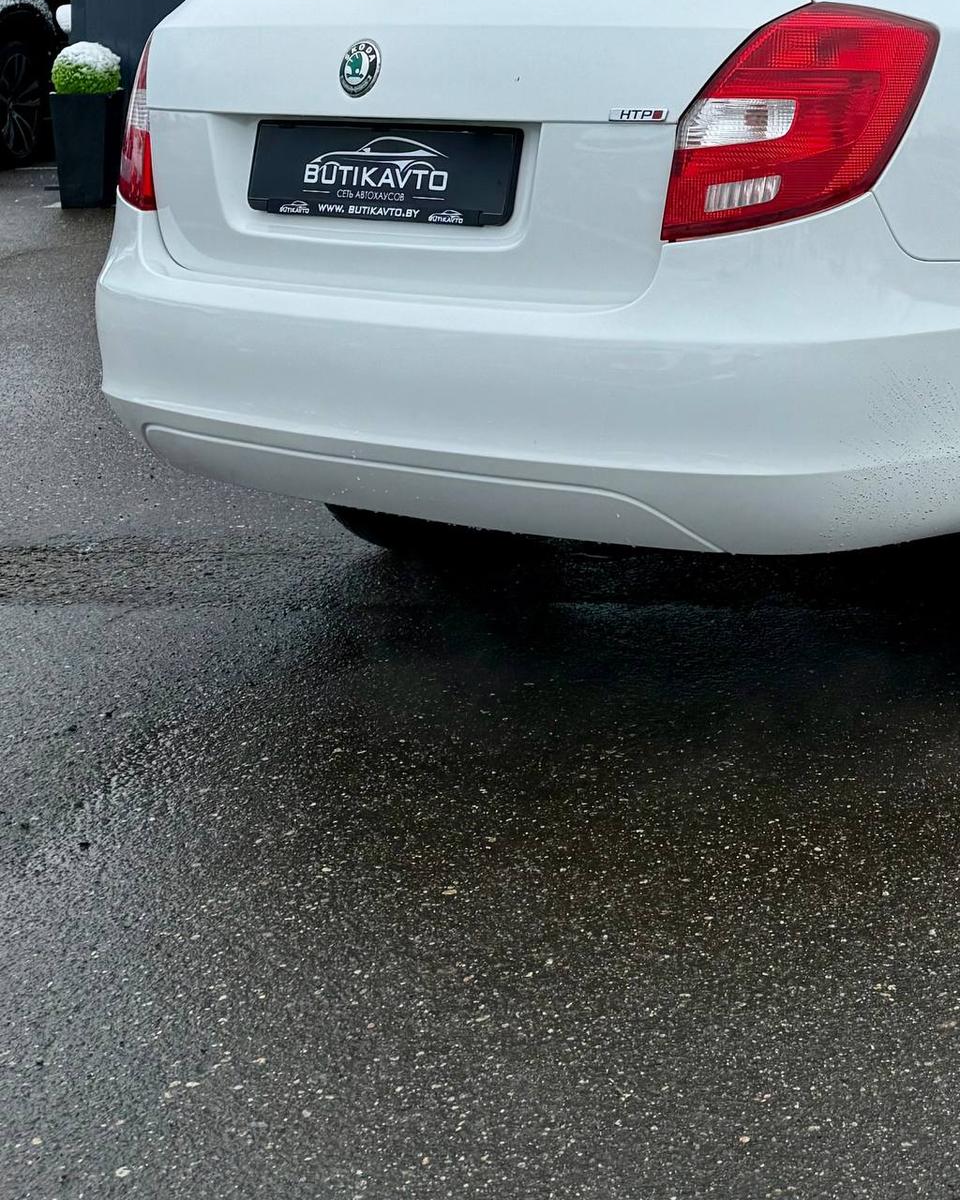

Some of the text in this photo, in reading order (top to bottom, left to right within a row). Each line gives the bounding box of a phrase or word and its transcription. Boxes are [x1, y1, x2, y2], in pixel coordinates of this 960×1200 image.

[620, 109, 653, 120] HTP
[303, 163, 449, 191] BUTIKAVTO
[337, 189, 405, 201] СЕТЬ АВТОХАУСОВ
[318, 203, 420, 218] WWW. BUTIKAVTO.BY
